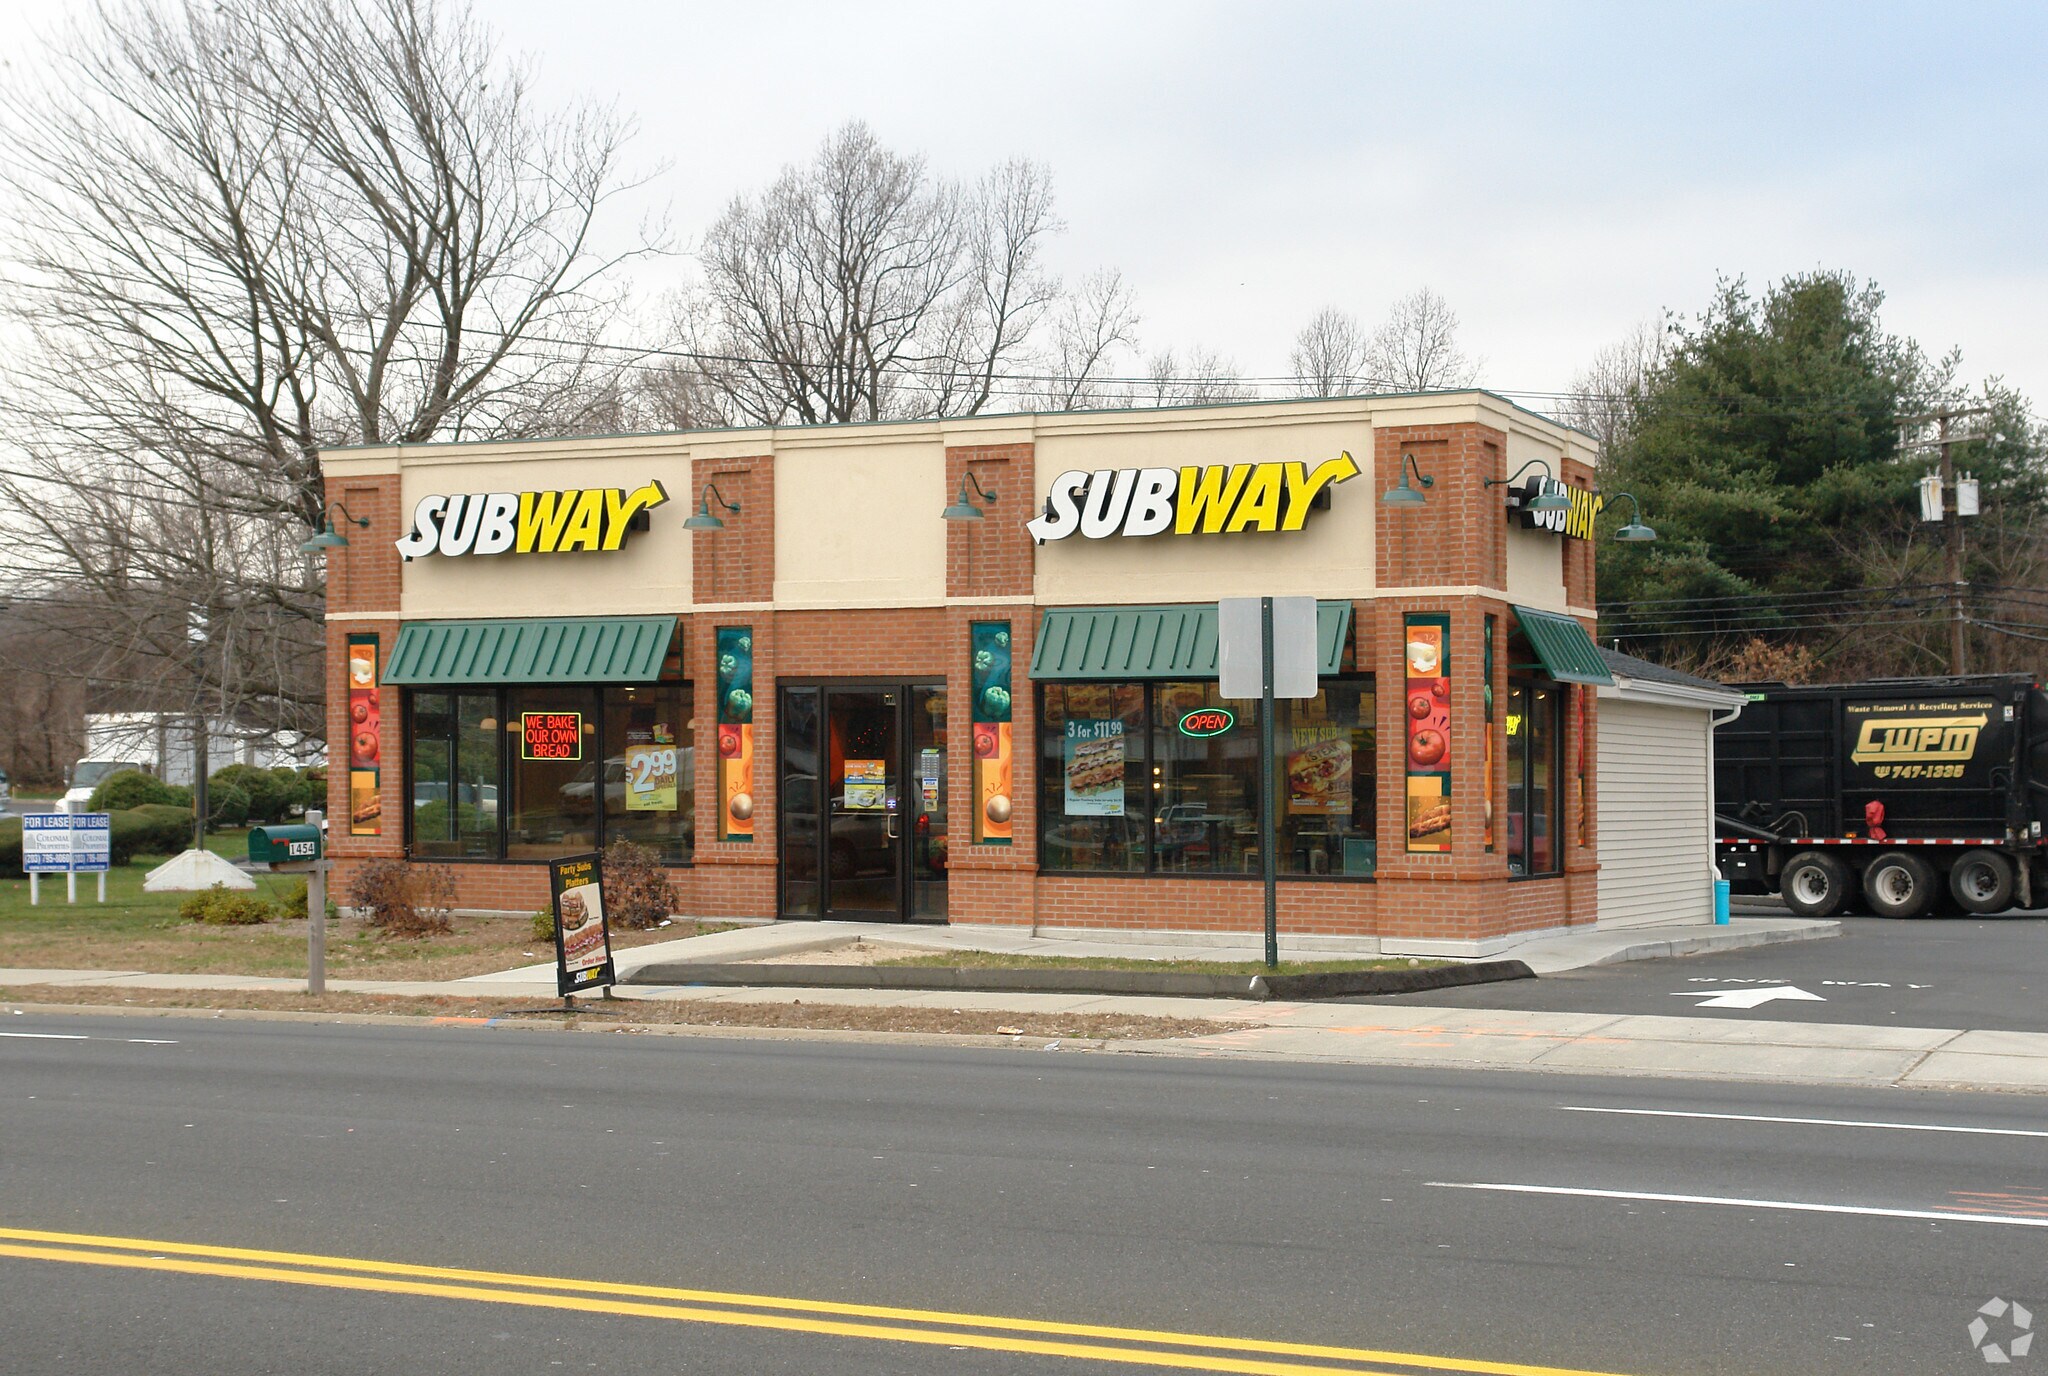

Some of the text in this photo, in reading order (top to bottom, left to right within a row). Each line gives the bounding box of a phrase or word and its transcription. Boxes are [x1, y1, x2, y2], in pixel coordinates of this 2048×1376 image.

[1026, 451, 1361, 545] SUBWAY
[395, 479, 670, 562] SUBWAY
[1848, 705, 1870, 713] Waste
[1873, 704, 1907, 712] Removal
[1919, 702, 1958, 711] Recycling
[1960, 701, 1993, 709] Services
[526, 715, 576, 729] WE BAKE
[1185, 715, 1227, 730] OPEN
[526, 730, 577, 743] OUR OWN
[1068, 721, 1123, 738] 3 for $11.99
[1292, 727, 1338, 750] NEW SUB
[1853, 716, 1984, 761] CWPM
[533, 744, 570, 757] BREAD
[1891, 765, 1965, 779] 747-1335
[24, 816, 70, 828] FOR LEASE
[73, 817, 109, 828] FOR LEASE
[290, 842, 314, 856] 1454
[560, 862, 592, 876] Party Subs
[565, 877, 589, 889] Platters
[574, 967, 601, 984] SUBWAY
